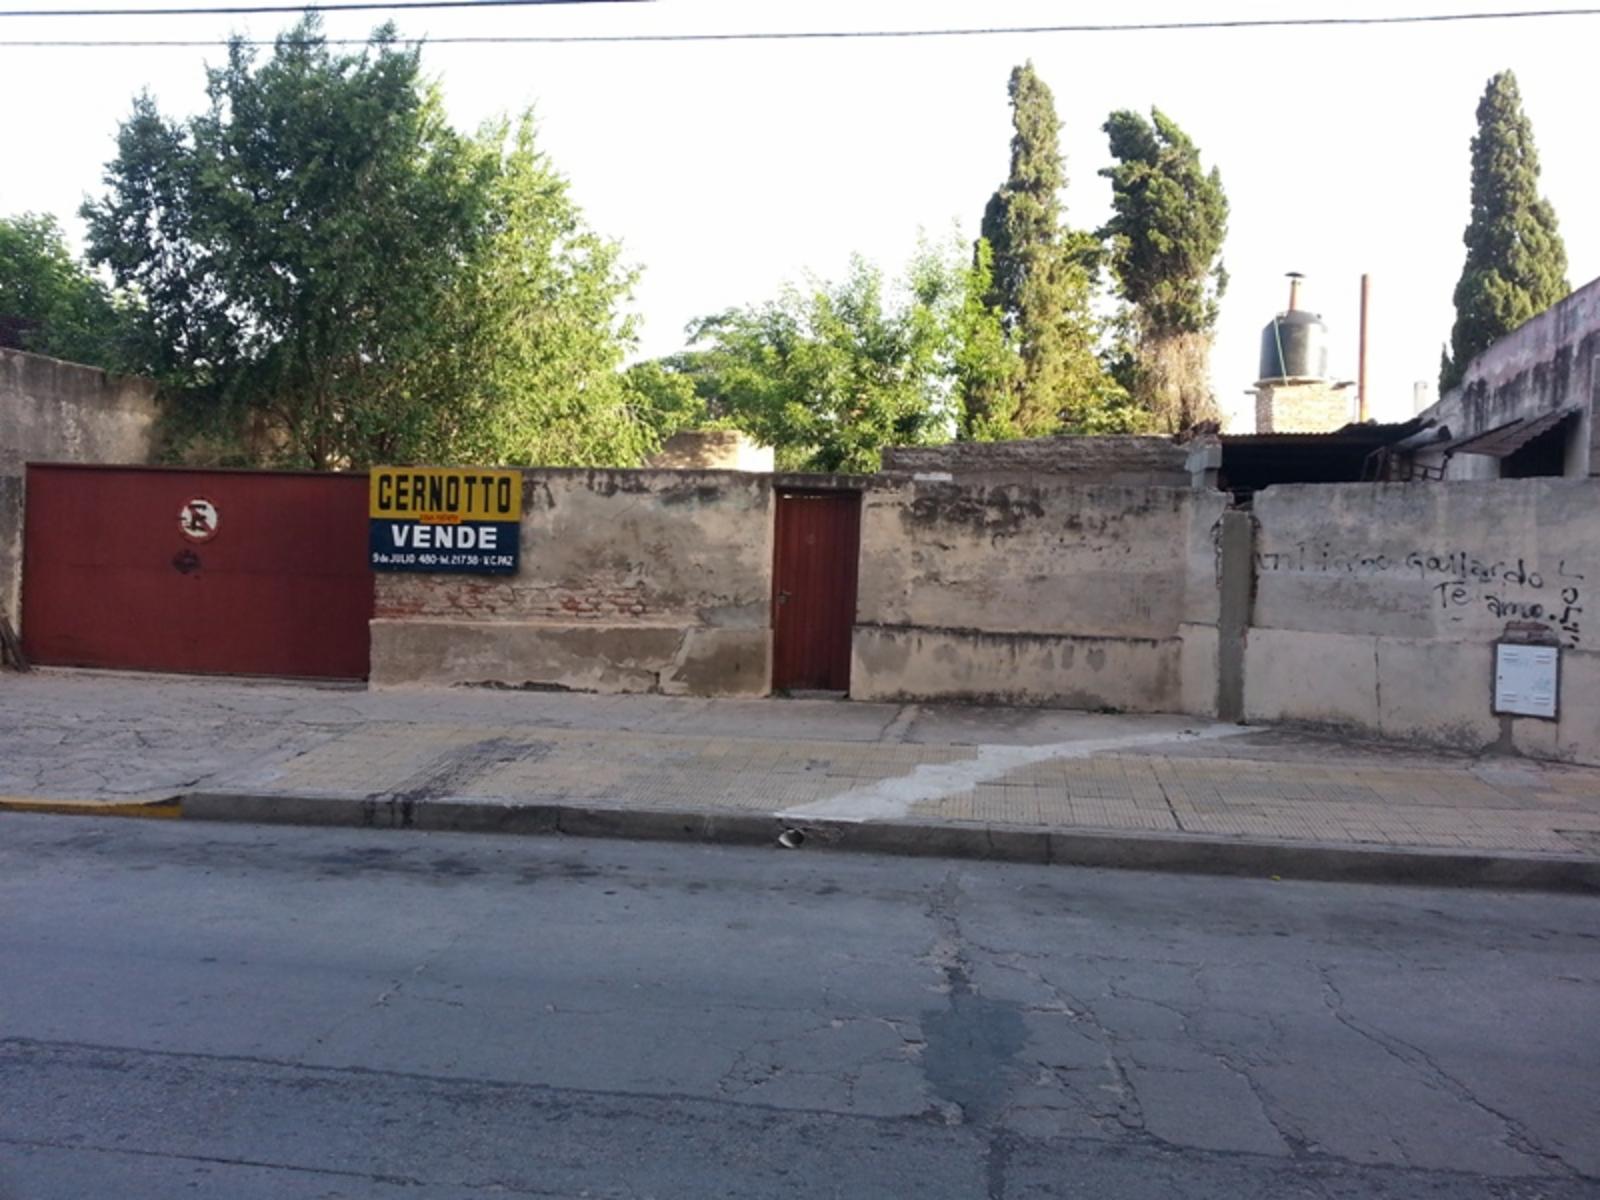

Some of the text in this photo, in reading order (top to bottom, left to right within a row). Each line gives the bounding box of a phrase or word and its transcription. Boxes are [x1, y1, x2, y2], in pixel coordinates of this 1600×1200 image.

[378, 473, 512, 514] CERNOTTO
[391, 524, 498, 549] VENDE
[390, 553, 416, 564] JULIO
[1406, 551, 1544, 589] Gallardo
[1434, 580, 1471, 608] Te
